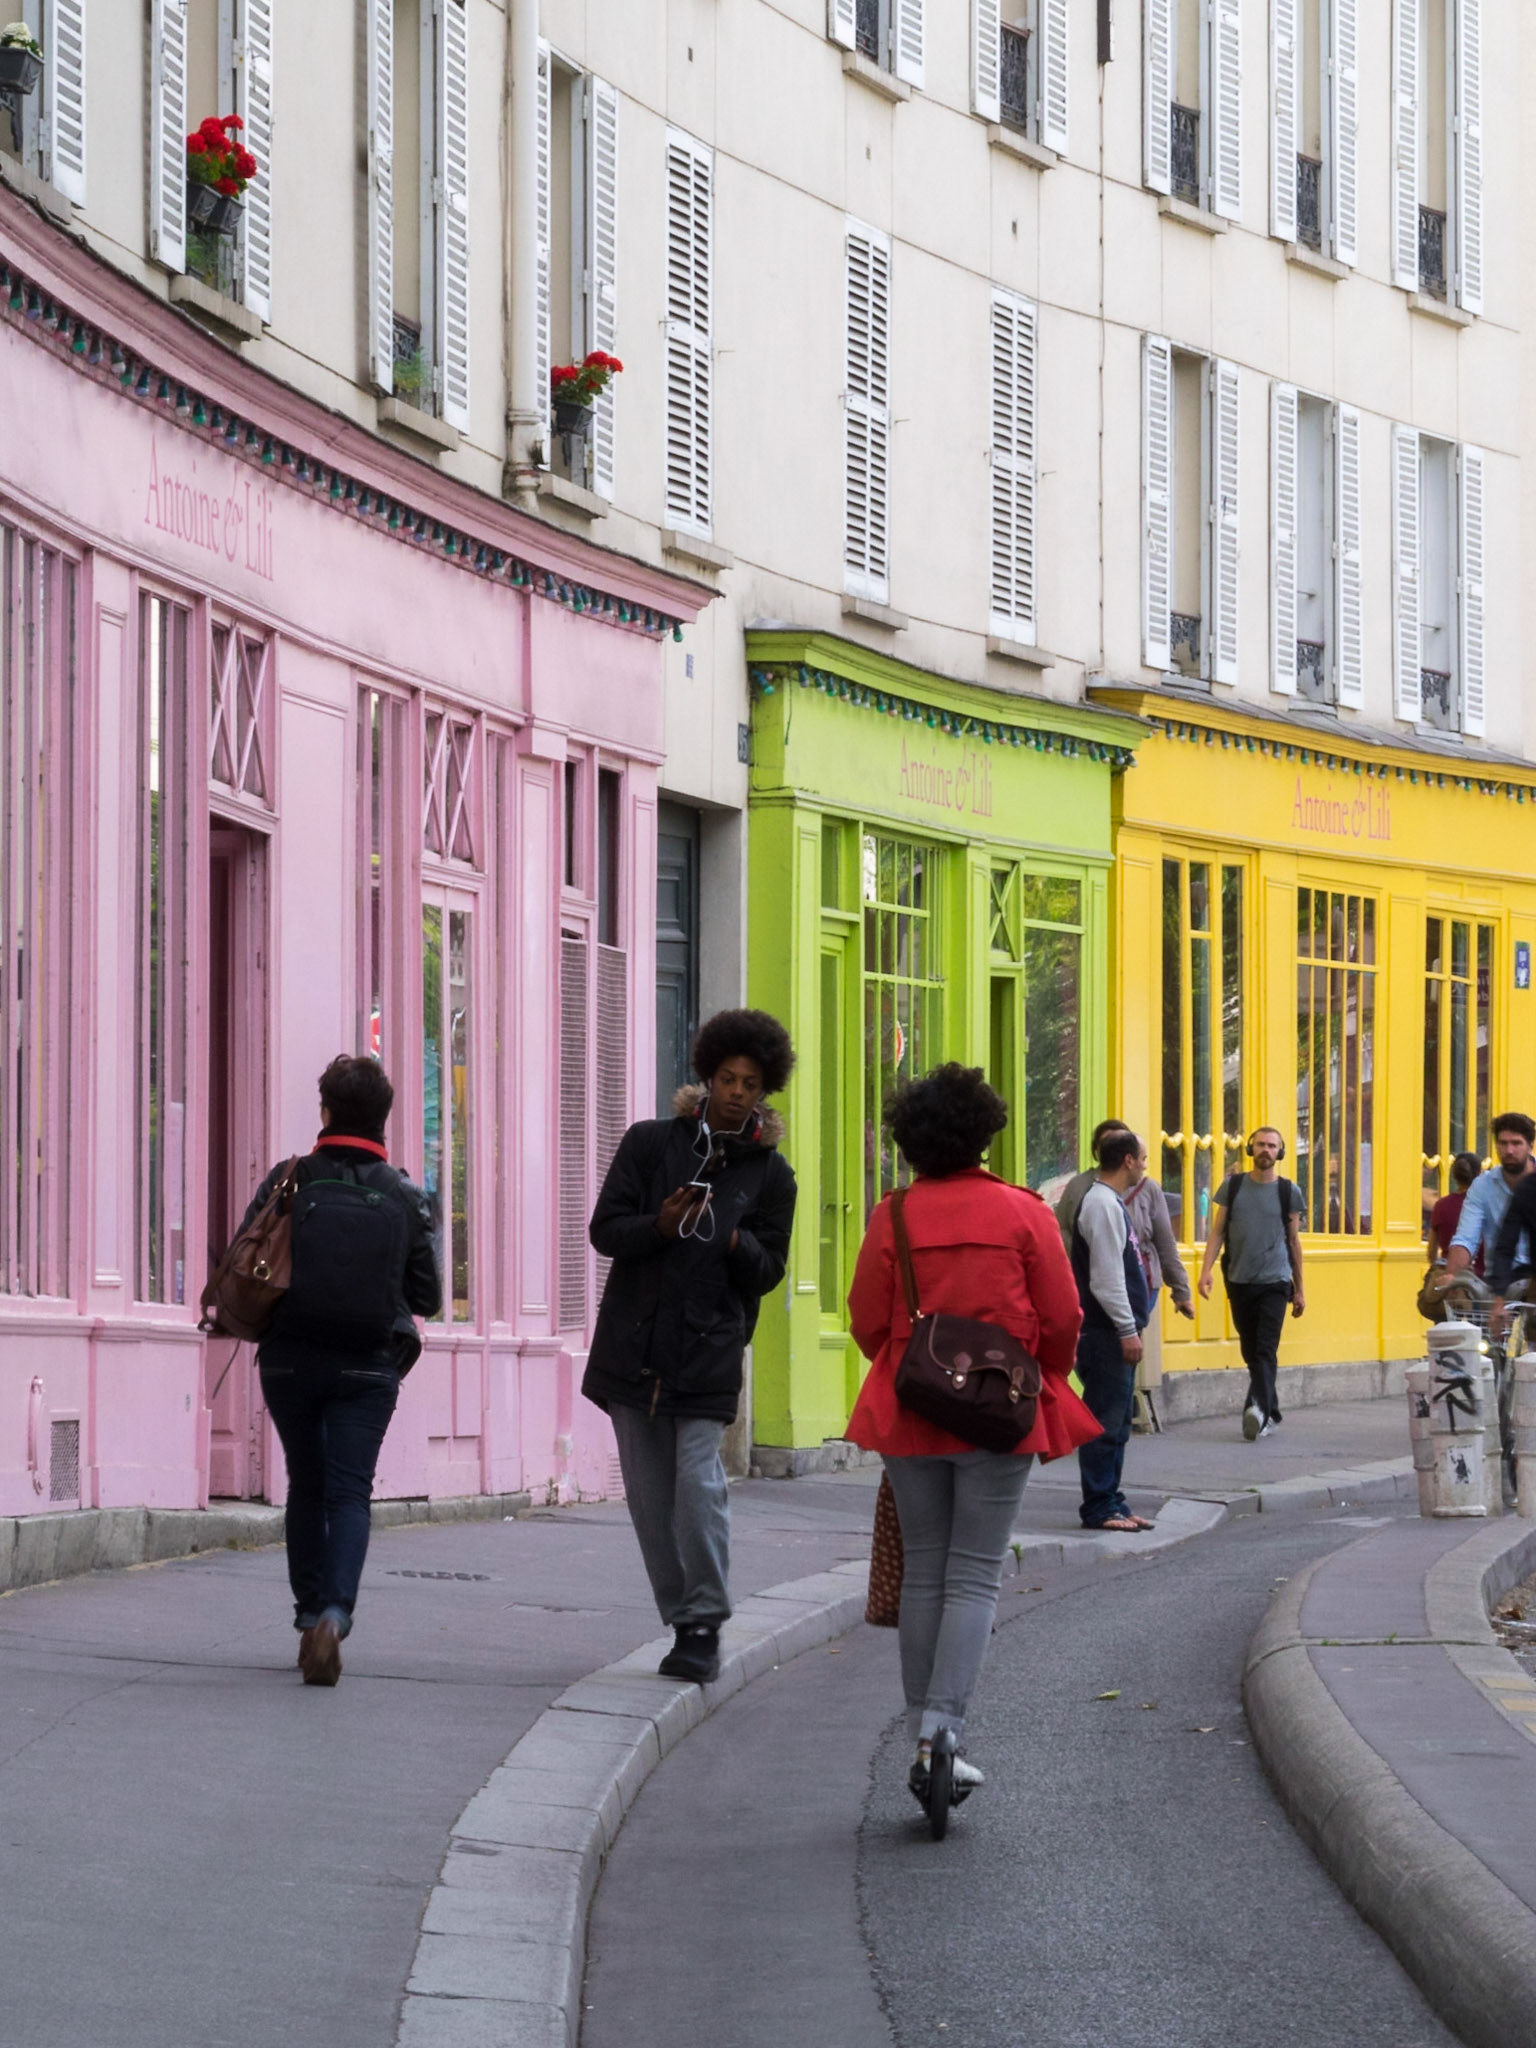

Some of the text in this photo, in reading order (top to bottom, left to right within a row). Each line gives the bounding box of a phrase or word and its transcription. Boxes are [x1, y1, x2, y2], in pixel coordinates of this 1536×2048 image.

[144, 432, 273, 582] Antoine & Lili
[899, 736, 992, 818] Antoine & Lili
[1291, 776, 1390, 840] Antoine & Lili
